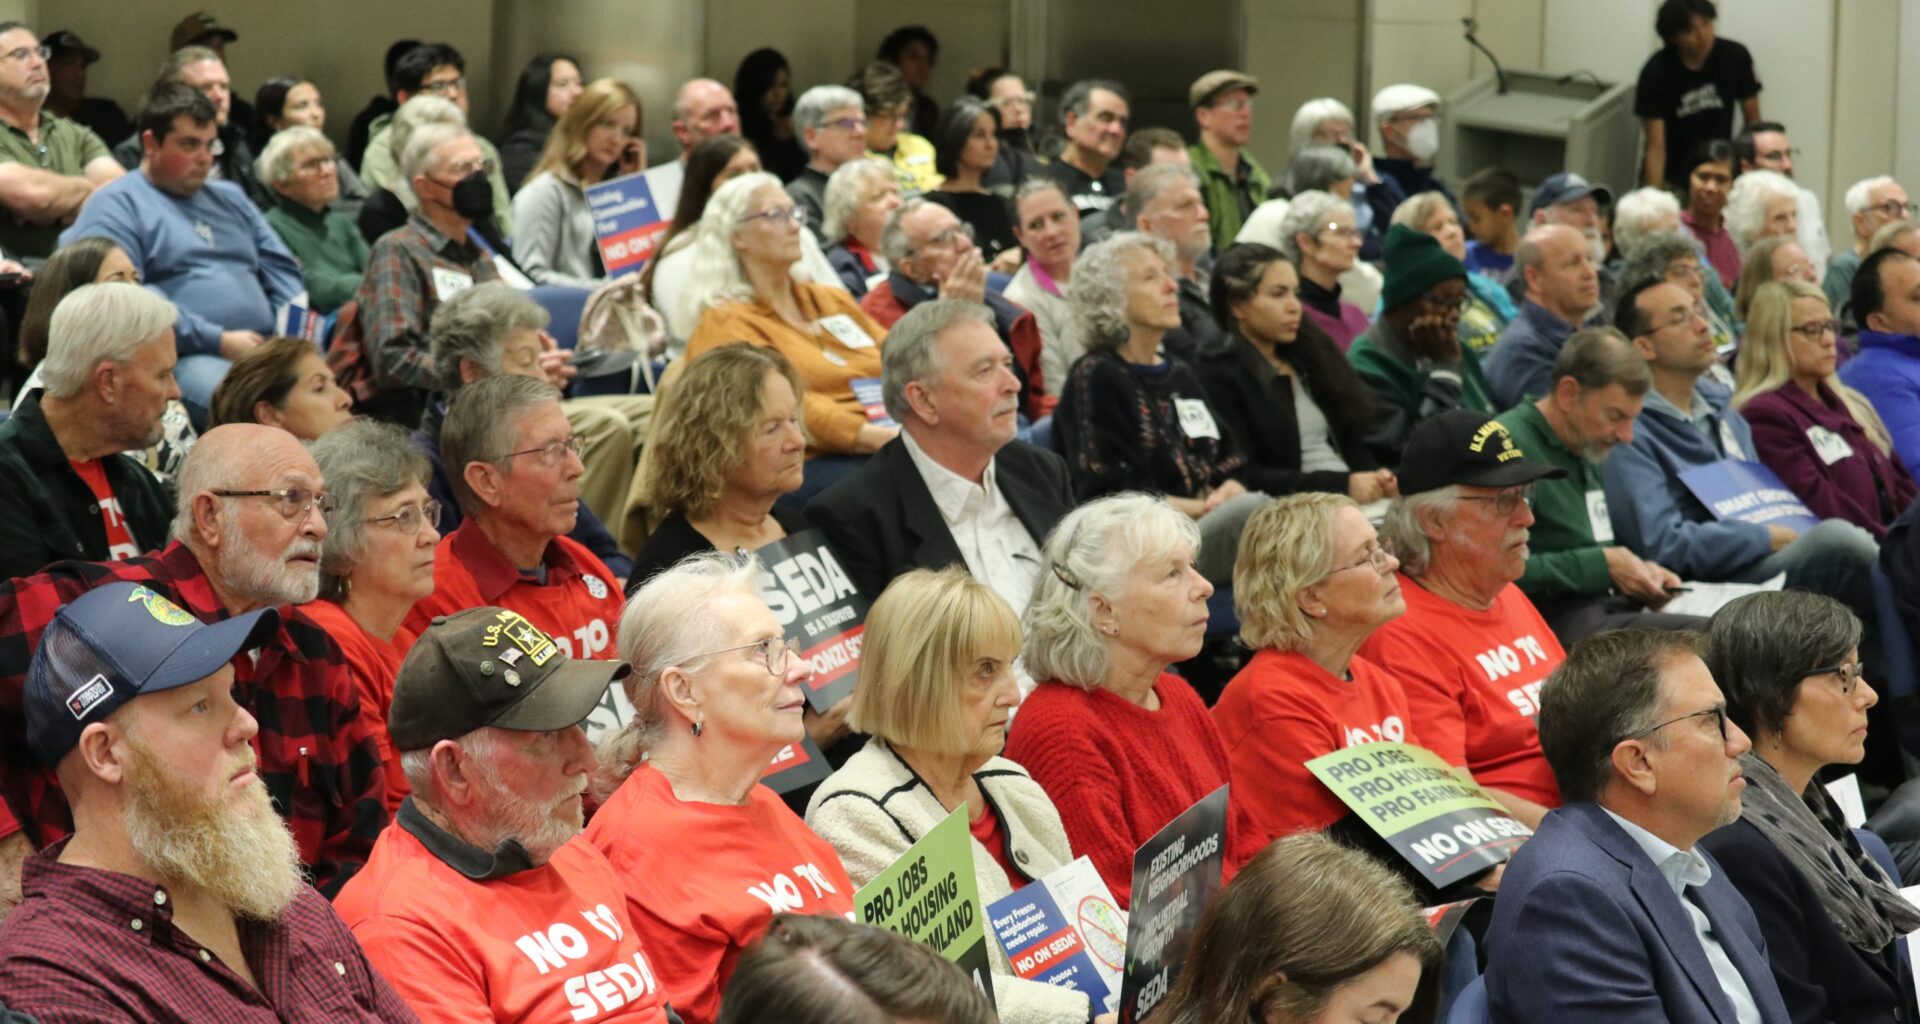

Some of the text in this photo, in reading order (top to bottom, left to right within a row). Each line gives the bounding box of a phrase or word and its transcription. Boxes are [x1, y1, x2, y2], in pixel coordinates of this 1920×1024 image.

[753, 545, 859, 626] SEDA
[573, 618, 610, 660] TO
[804, 621, 817, 638] IS
[815, 618, 827, 633] A
[1475, 644, 1521, 682] NO
[1326, 748, 1415, 783] PRO JOBS
[1348, 776, 1395, 803] PRO
[1369, 796, 1417, 823] PRO
[1150, 834, 1186, 875] EXISTING
[1410, 832, 1460, 865] NO
[1453, 820, 1499, 846] ON
[1147, 833, 1219, 903] NEIGHBORHOODS
[864, 855, 928, 925] PRO JOBS
[901, 871, 958, 940] HOUSING
[993, 902, 1037, 930] Every Fresno
[999, 909, 1046, 940] neighborhood
[1142, 889, 1189, 940] INDUSTRIAL
[514, 921, 589, 976] NO
[1005, 922, 1049, 950] needs repair.
[1142, 920, 1176, 966] GROWTH
[1015, 955, 1036, 974] NO
[1034, 947, 1052, 963] ON
[1135, 965, 1168, 1022] SEDA
